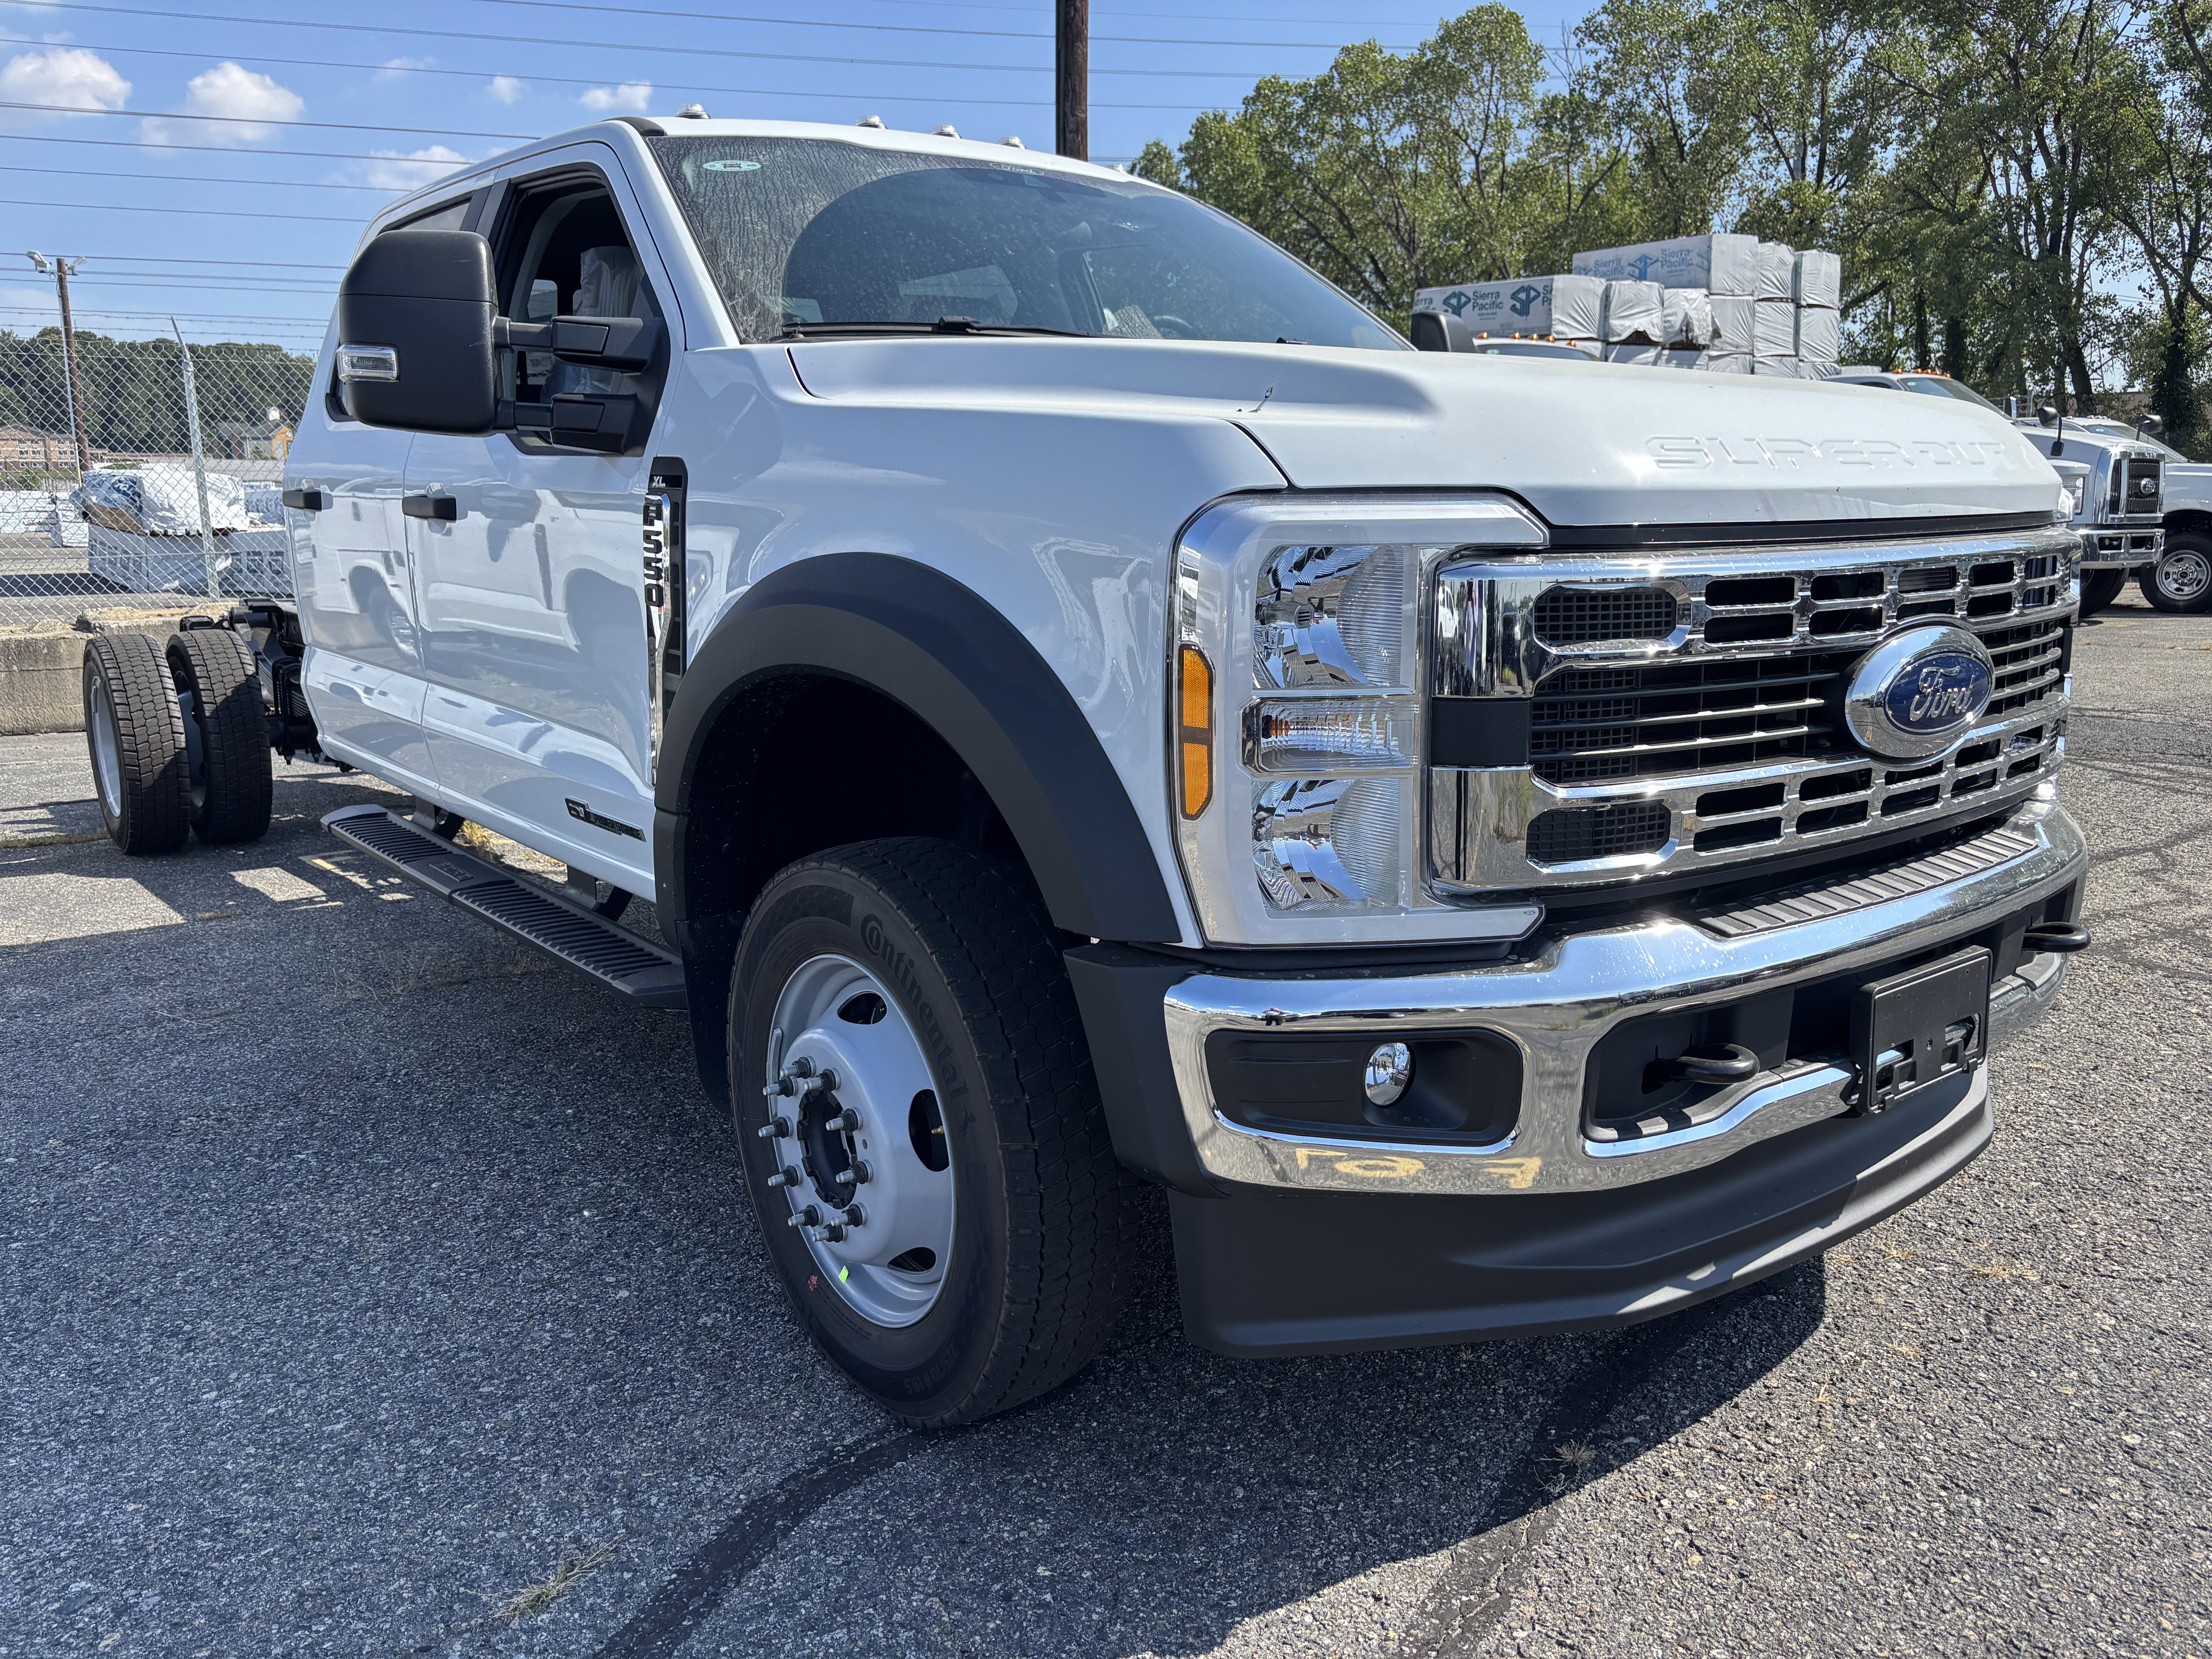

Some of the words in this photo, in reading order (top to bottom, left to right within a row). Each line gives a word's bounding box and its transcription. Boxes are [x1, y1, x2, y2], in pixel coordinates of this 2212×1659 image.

[1472, 291, 1500, 301] Sierra
[1472, 300, 1504, 311] Pacific
[653, 476, 666, 487] XL
[1910, 665, 1975, 721] Ford
[860, 914, 969, 1103] Continental
